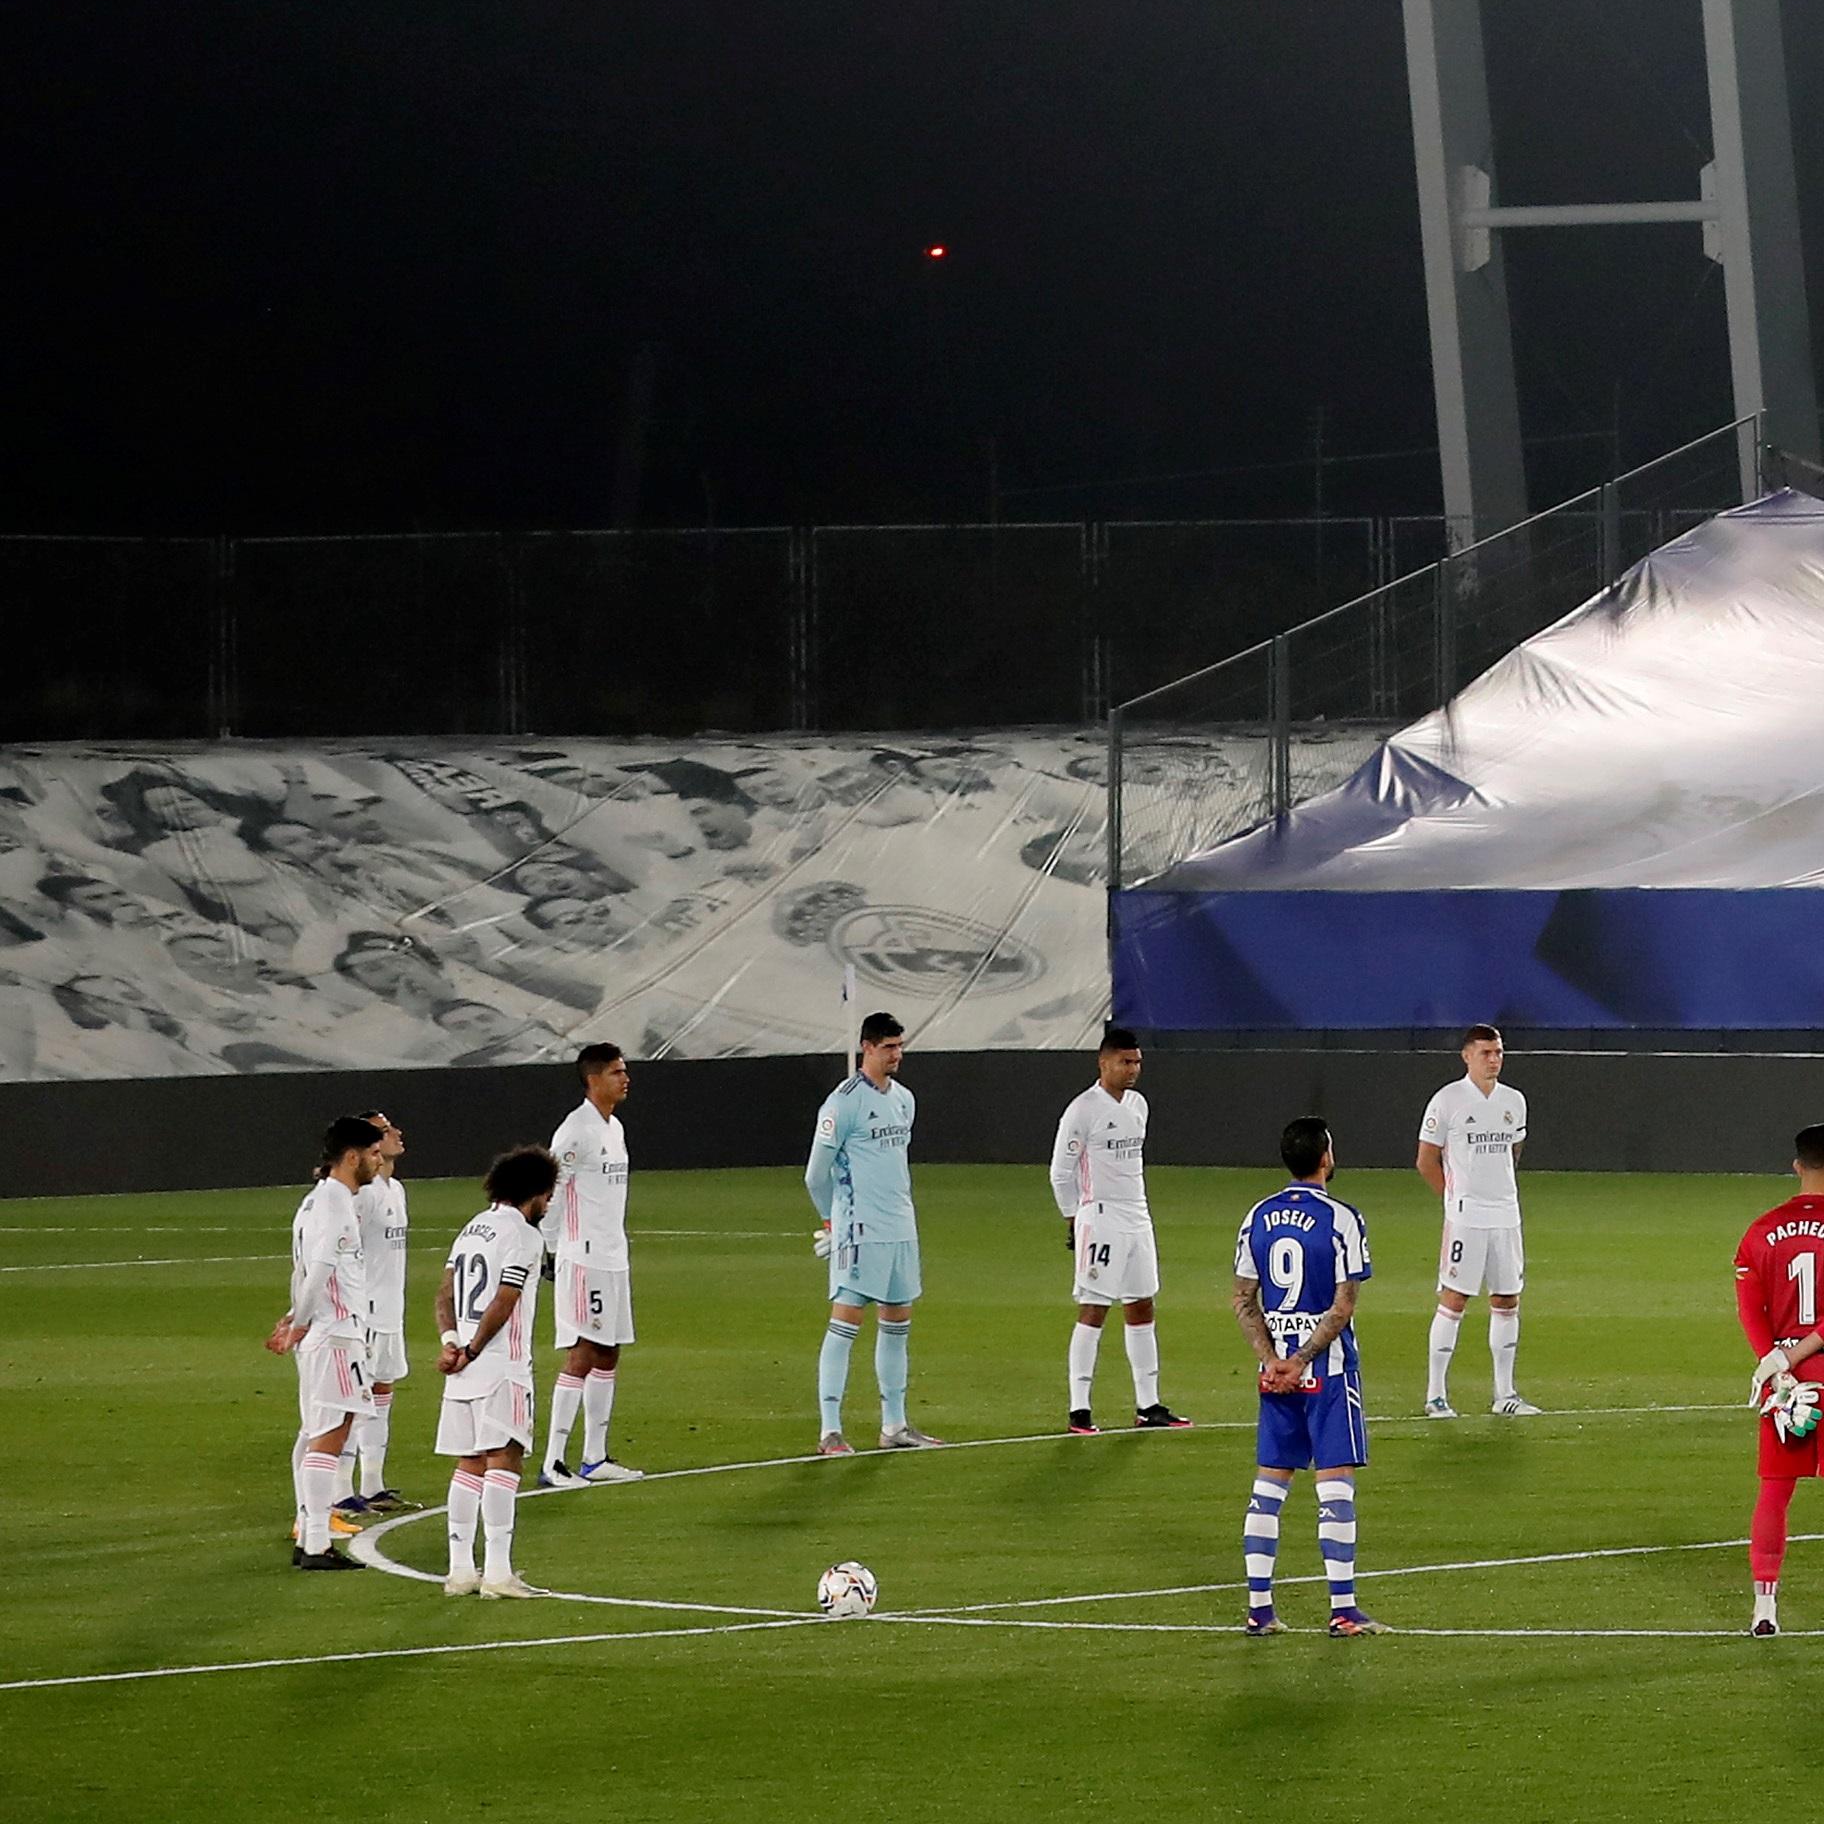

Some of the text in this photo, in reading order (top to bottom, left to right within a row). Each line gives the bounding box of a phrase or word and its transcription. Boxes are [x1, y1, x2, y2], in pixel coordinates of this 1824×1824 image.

[1263, 1209, 1316, 1232] JOSELU
[1088, 1241, 1111, 1267] 14
[1451, 1239, 1464, 1263] 8
[1269, 1236, 1304, 1312] 9
[452, 1252, 490, 1325] 12
[1787, 1251, 1816, 1326] 1
[589, 1290, 603, 1315] 5
